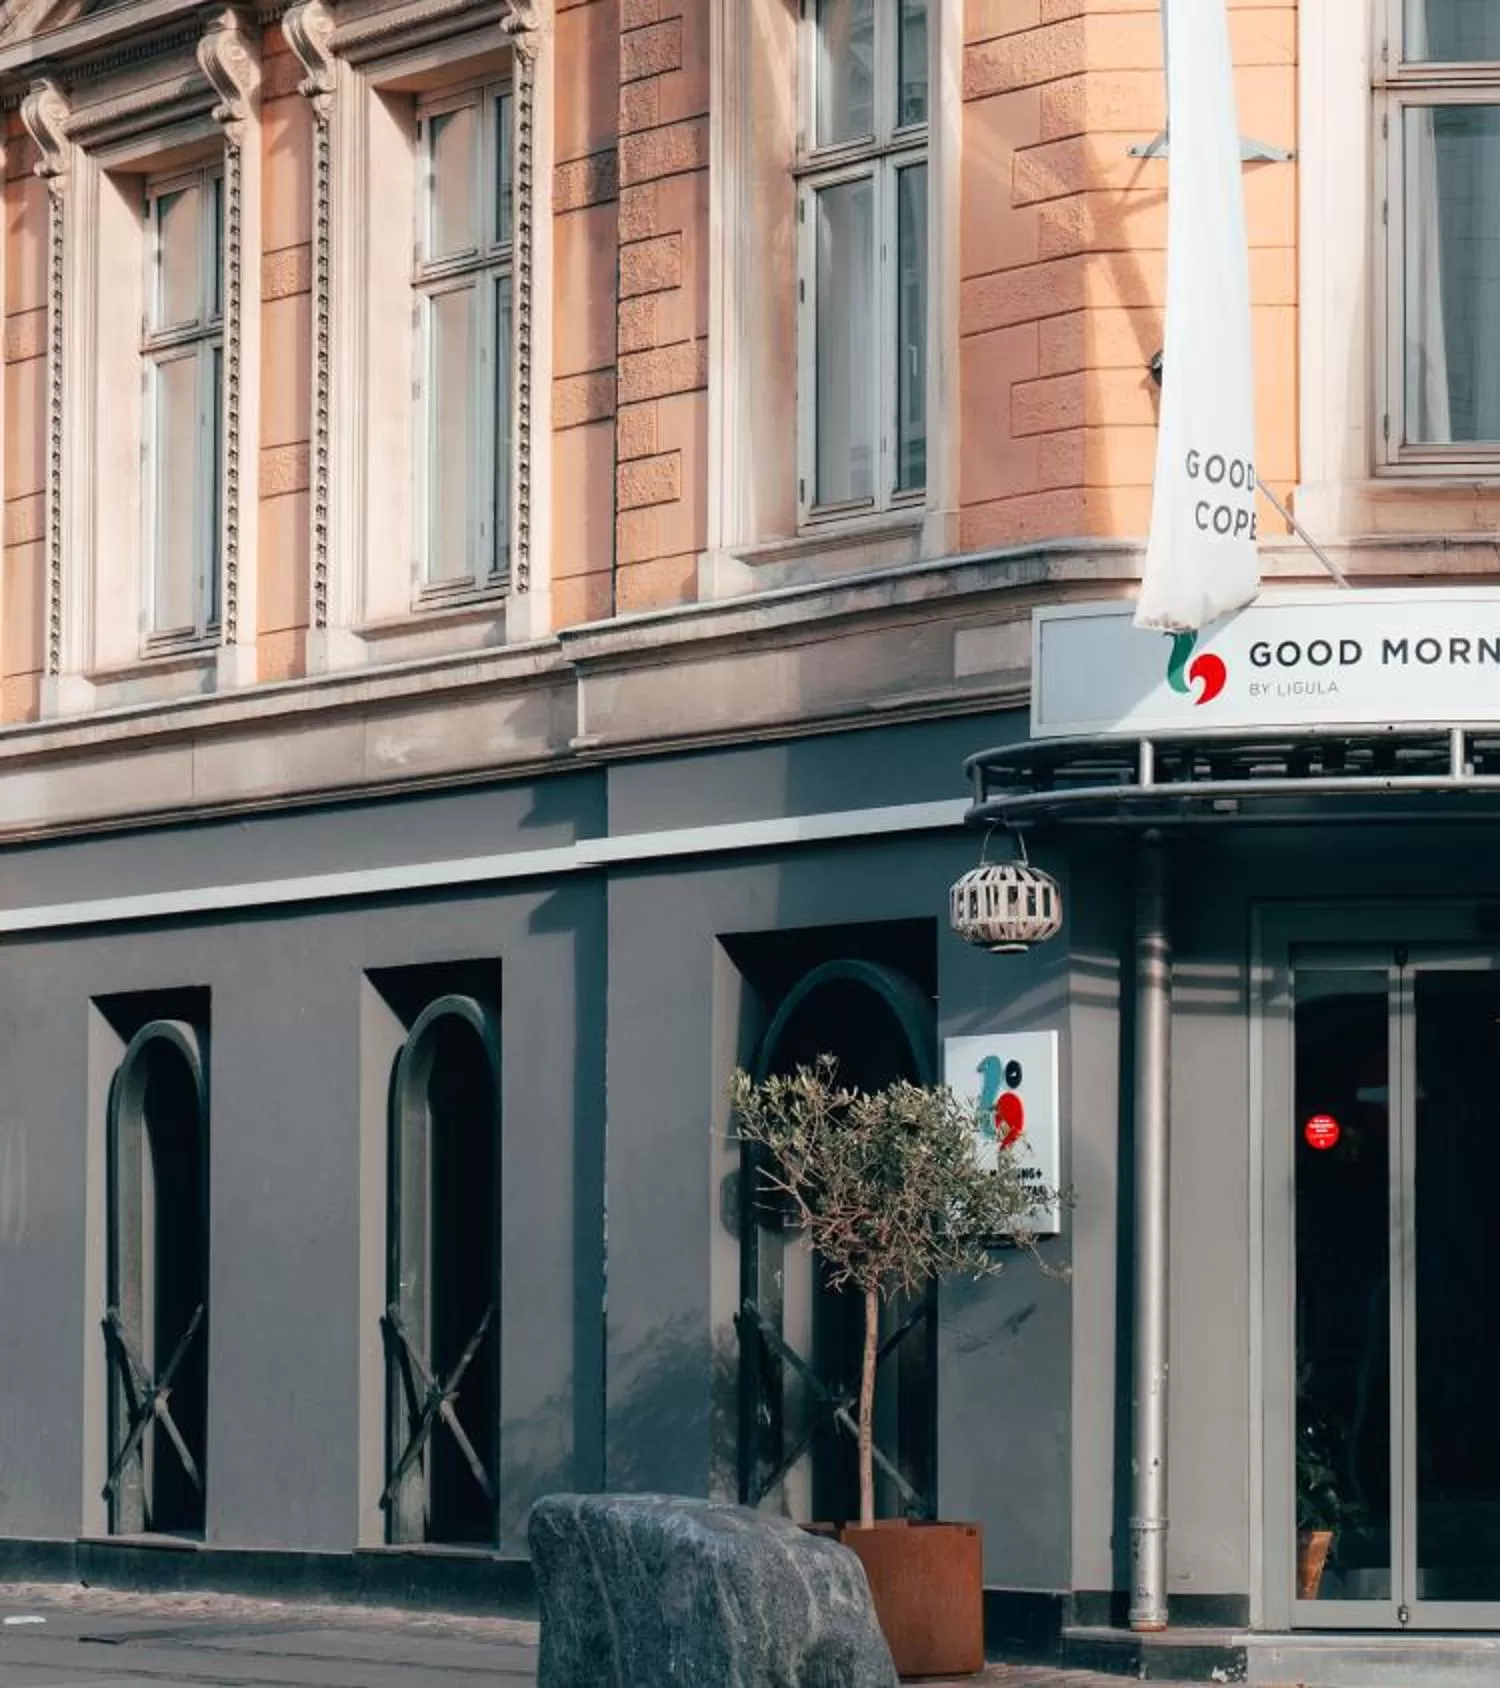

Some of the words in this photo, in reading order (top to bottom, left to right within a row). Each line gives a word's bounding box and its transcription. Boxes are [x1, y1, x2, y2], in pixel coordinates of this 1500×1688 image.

[1250, 639, 1362, 667] GOOD
[1249, 682, 1269, 697] BY
[1277, 680, 1340, 697] LIGULA
